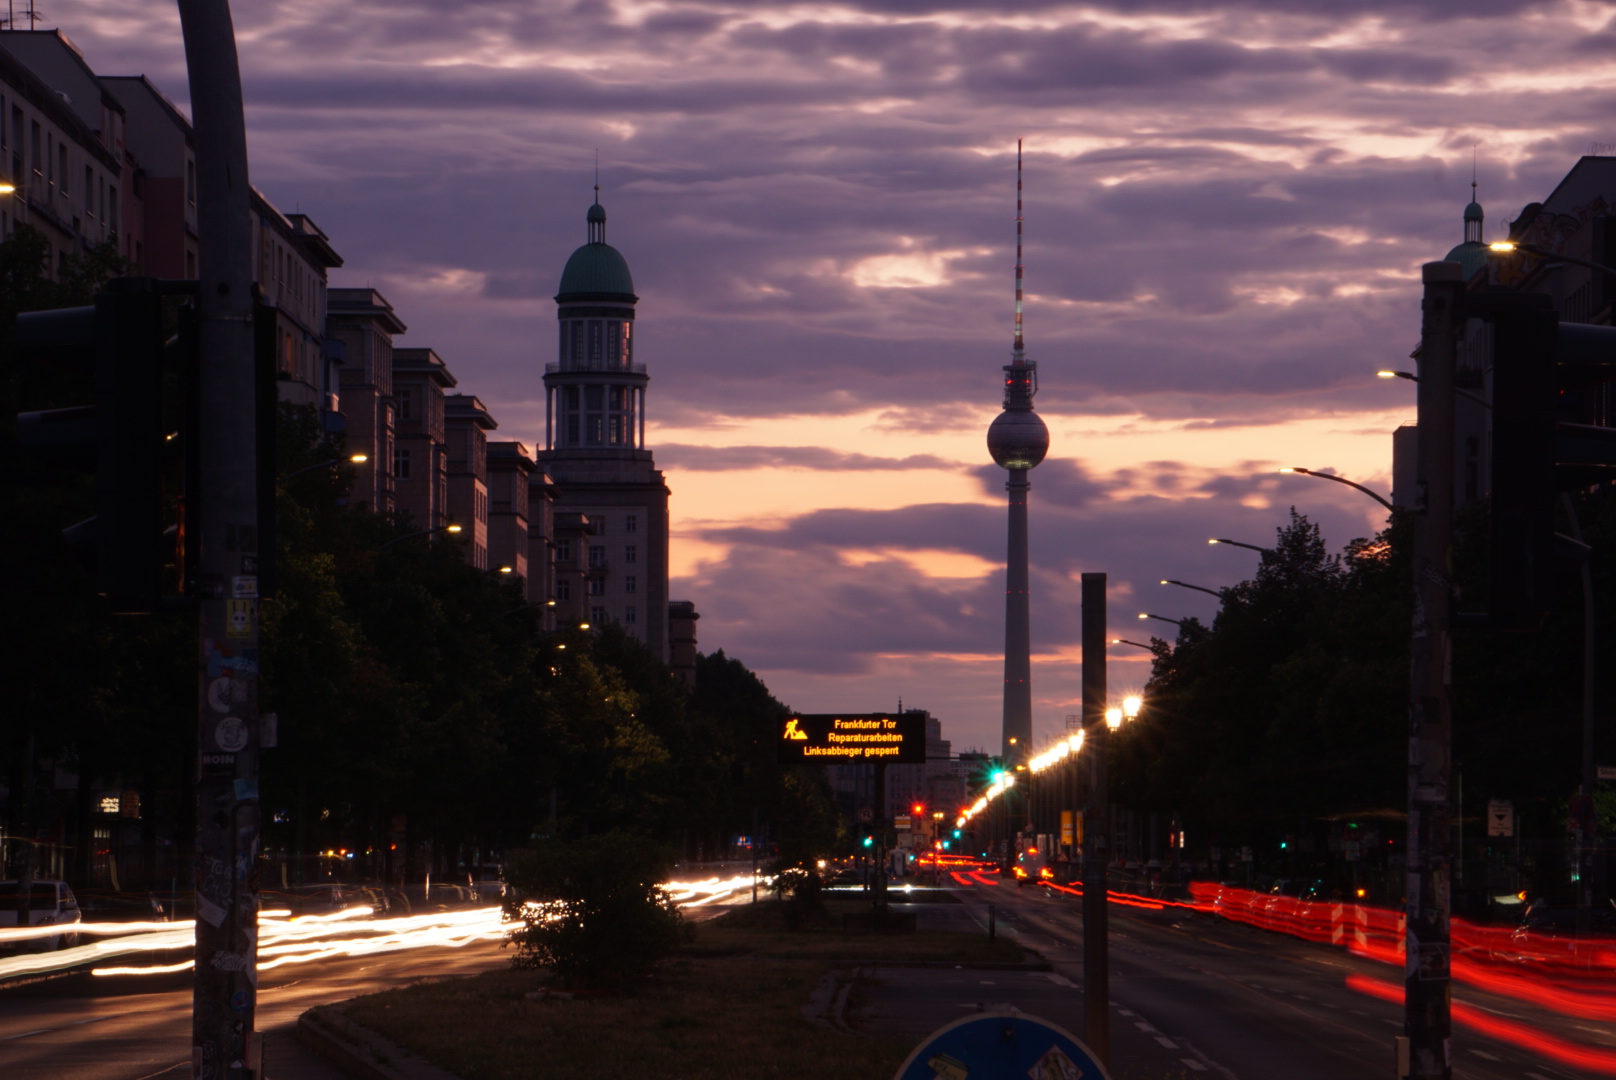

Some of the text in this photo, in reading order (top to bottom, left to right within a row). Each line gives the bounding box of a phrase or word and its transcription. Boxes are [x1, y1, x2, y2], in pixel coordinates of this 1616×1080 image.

[835, 719, 896, 729] Frankfurter Tor
[828, 733, 902, 744] Reparaturarbeiten
[804, 746, 899, 757] Linksabbieger gesperrt
[203, 755, 234, 764] MOIN
